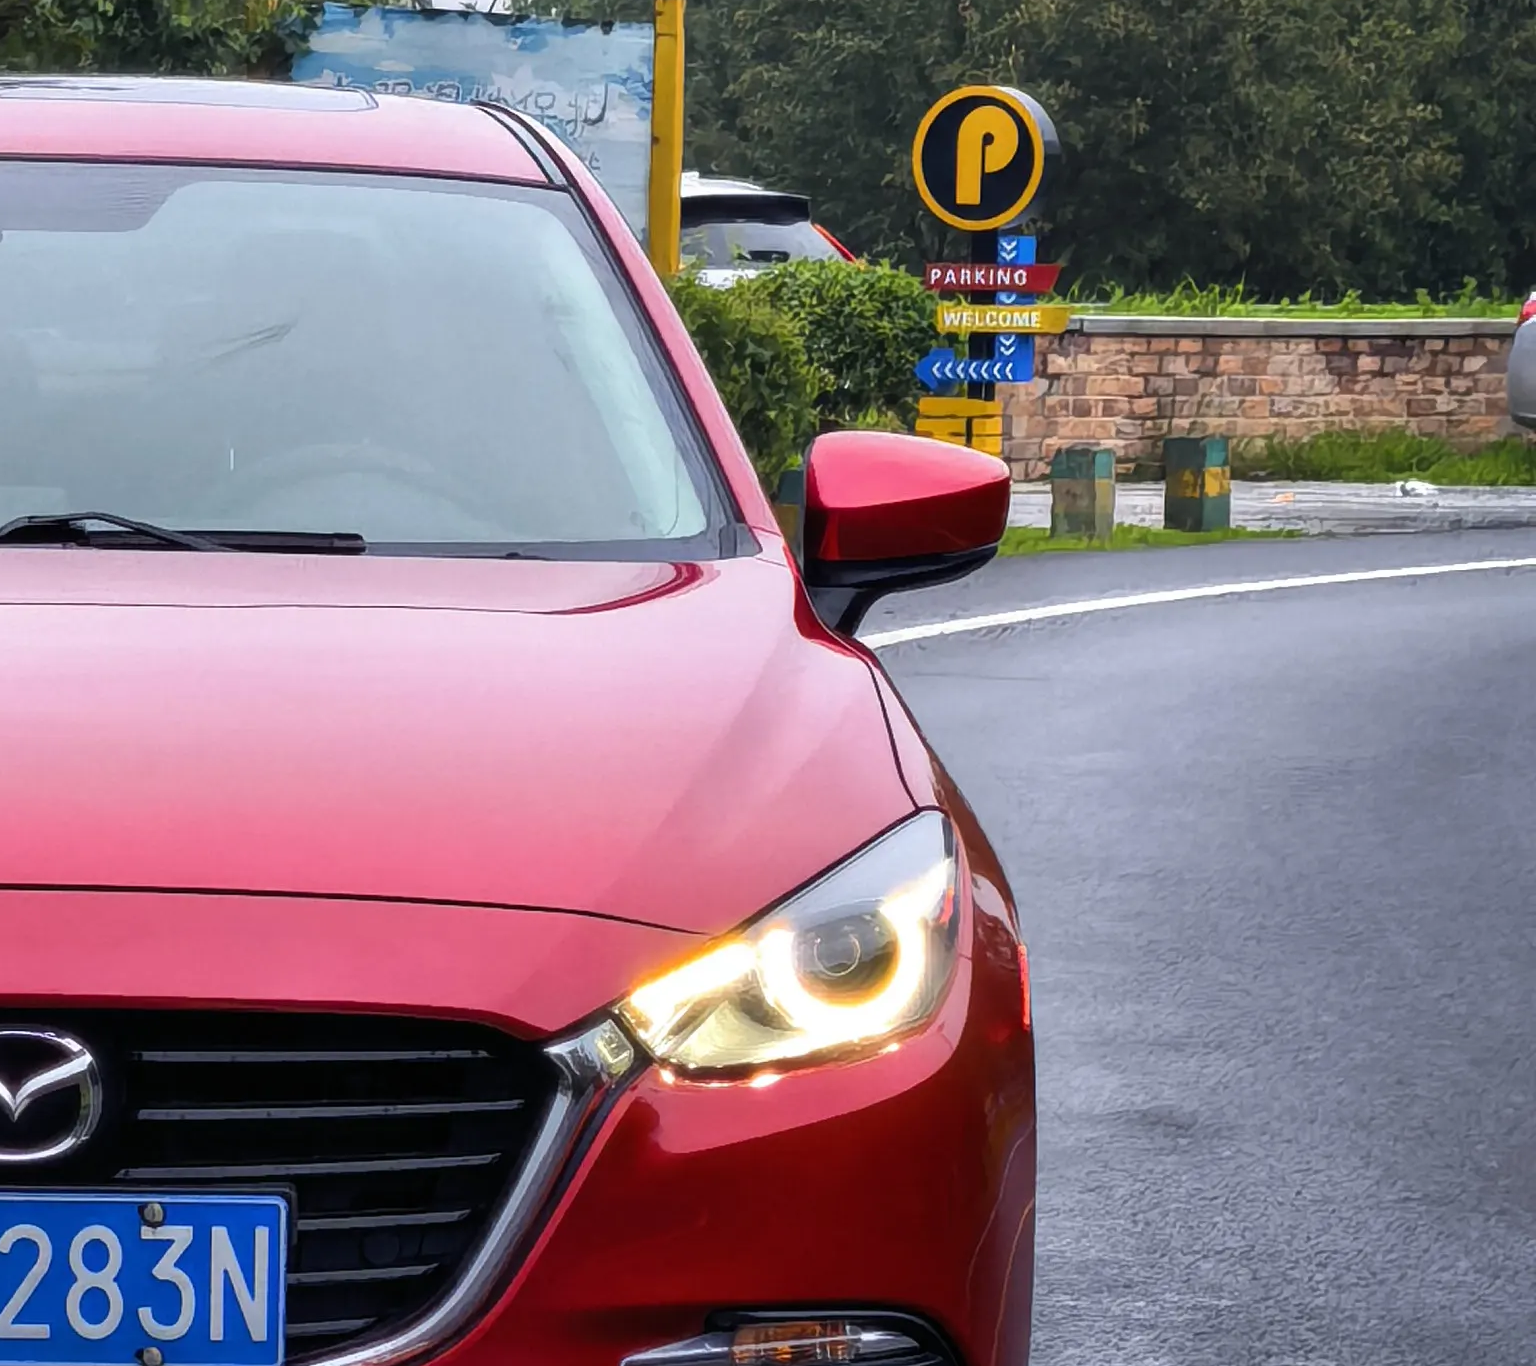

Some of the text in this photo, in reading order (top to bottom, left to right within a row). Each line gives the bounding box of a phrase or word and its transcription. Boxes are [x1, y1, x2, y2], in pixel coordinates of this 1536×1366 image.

[956, 105, 1018, 205] P
[930, 268, 1027, 286] PARKING
[944, 310, 1041, 328] WELCOME
